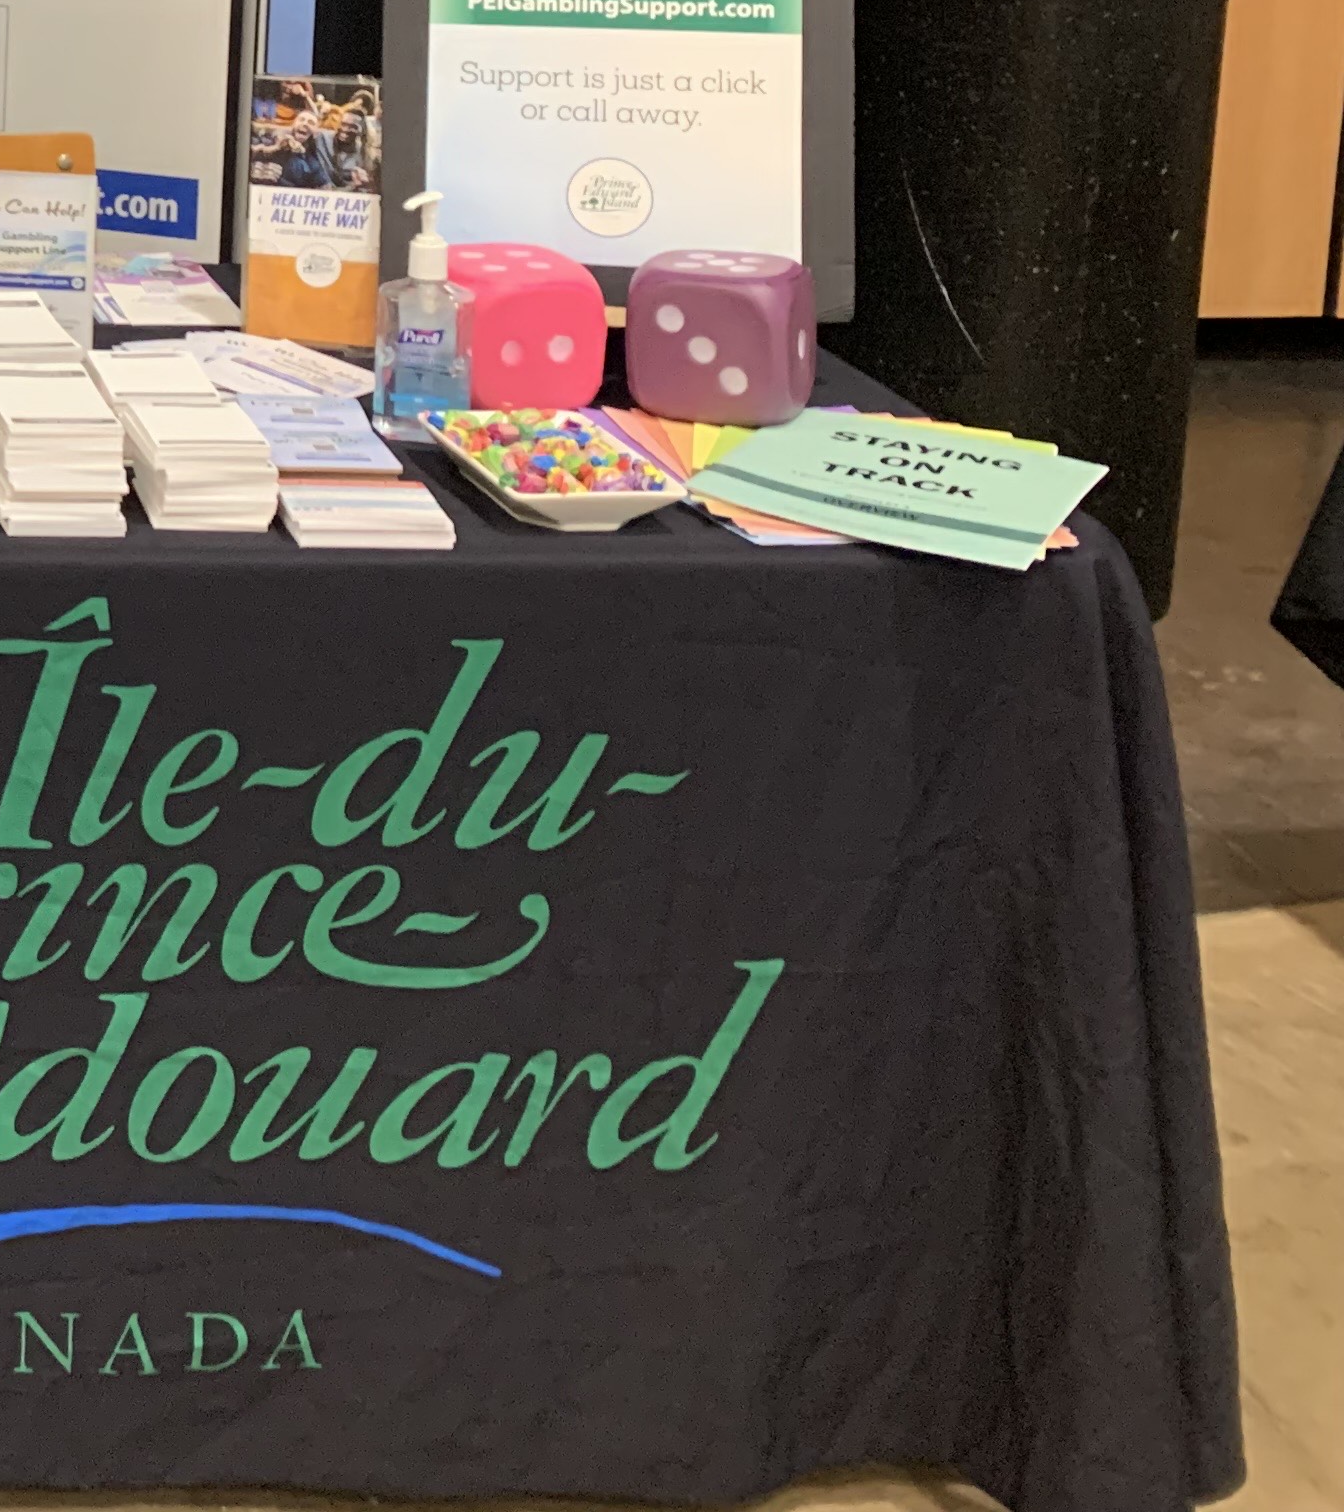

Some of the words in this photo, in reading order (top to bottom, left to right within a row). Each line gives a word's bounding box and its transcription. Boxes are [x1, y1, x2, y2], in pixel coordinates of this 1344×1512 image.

[460, 60, 574, 93] Support
[583, 65, 605, 90] is
[611, 65, 666, 95] just
[674, 74, 693, 93] a
[701, 68, 768, 96] click
[520, 101, 547, 122] or
[556, 97, 607, 123] call
[615, 104, 703, 133] away.
[5, 198, 39, 215] Can
[271, 193, 330, 210] HEALTHY
[335, 196, 372, 213] PLAY
[270, 208, 295, 225] ALL
[303, 210, 330, 227] THE
[336, 213, 369, 231] WAY
[2, 231, 59, 244] Gambling
[830, 431, 1022, 471] STAYING
[879, 456, 945, 475] ON
[823, 461, 979, 498] TRACK
